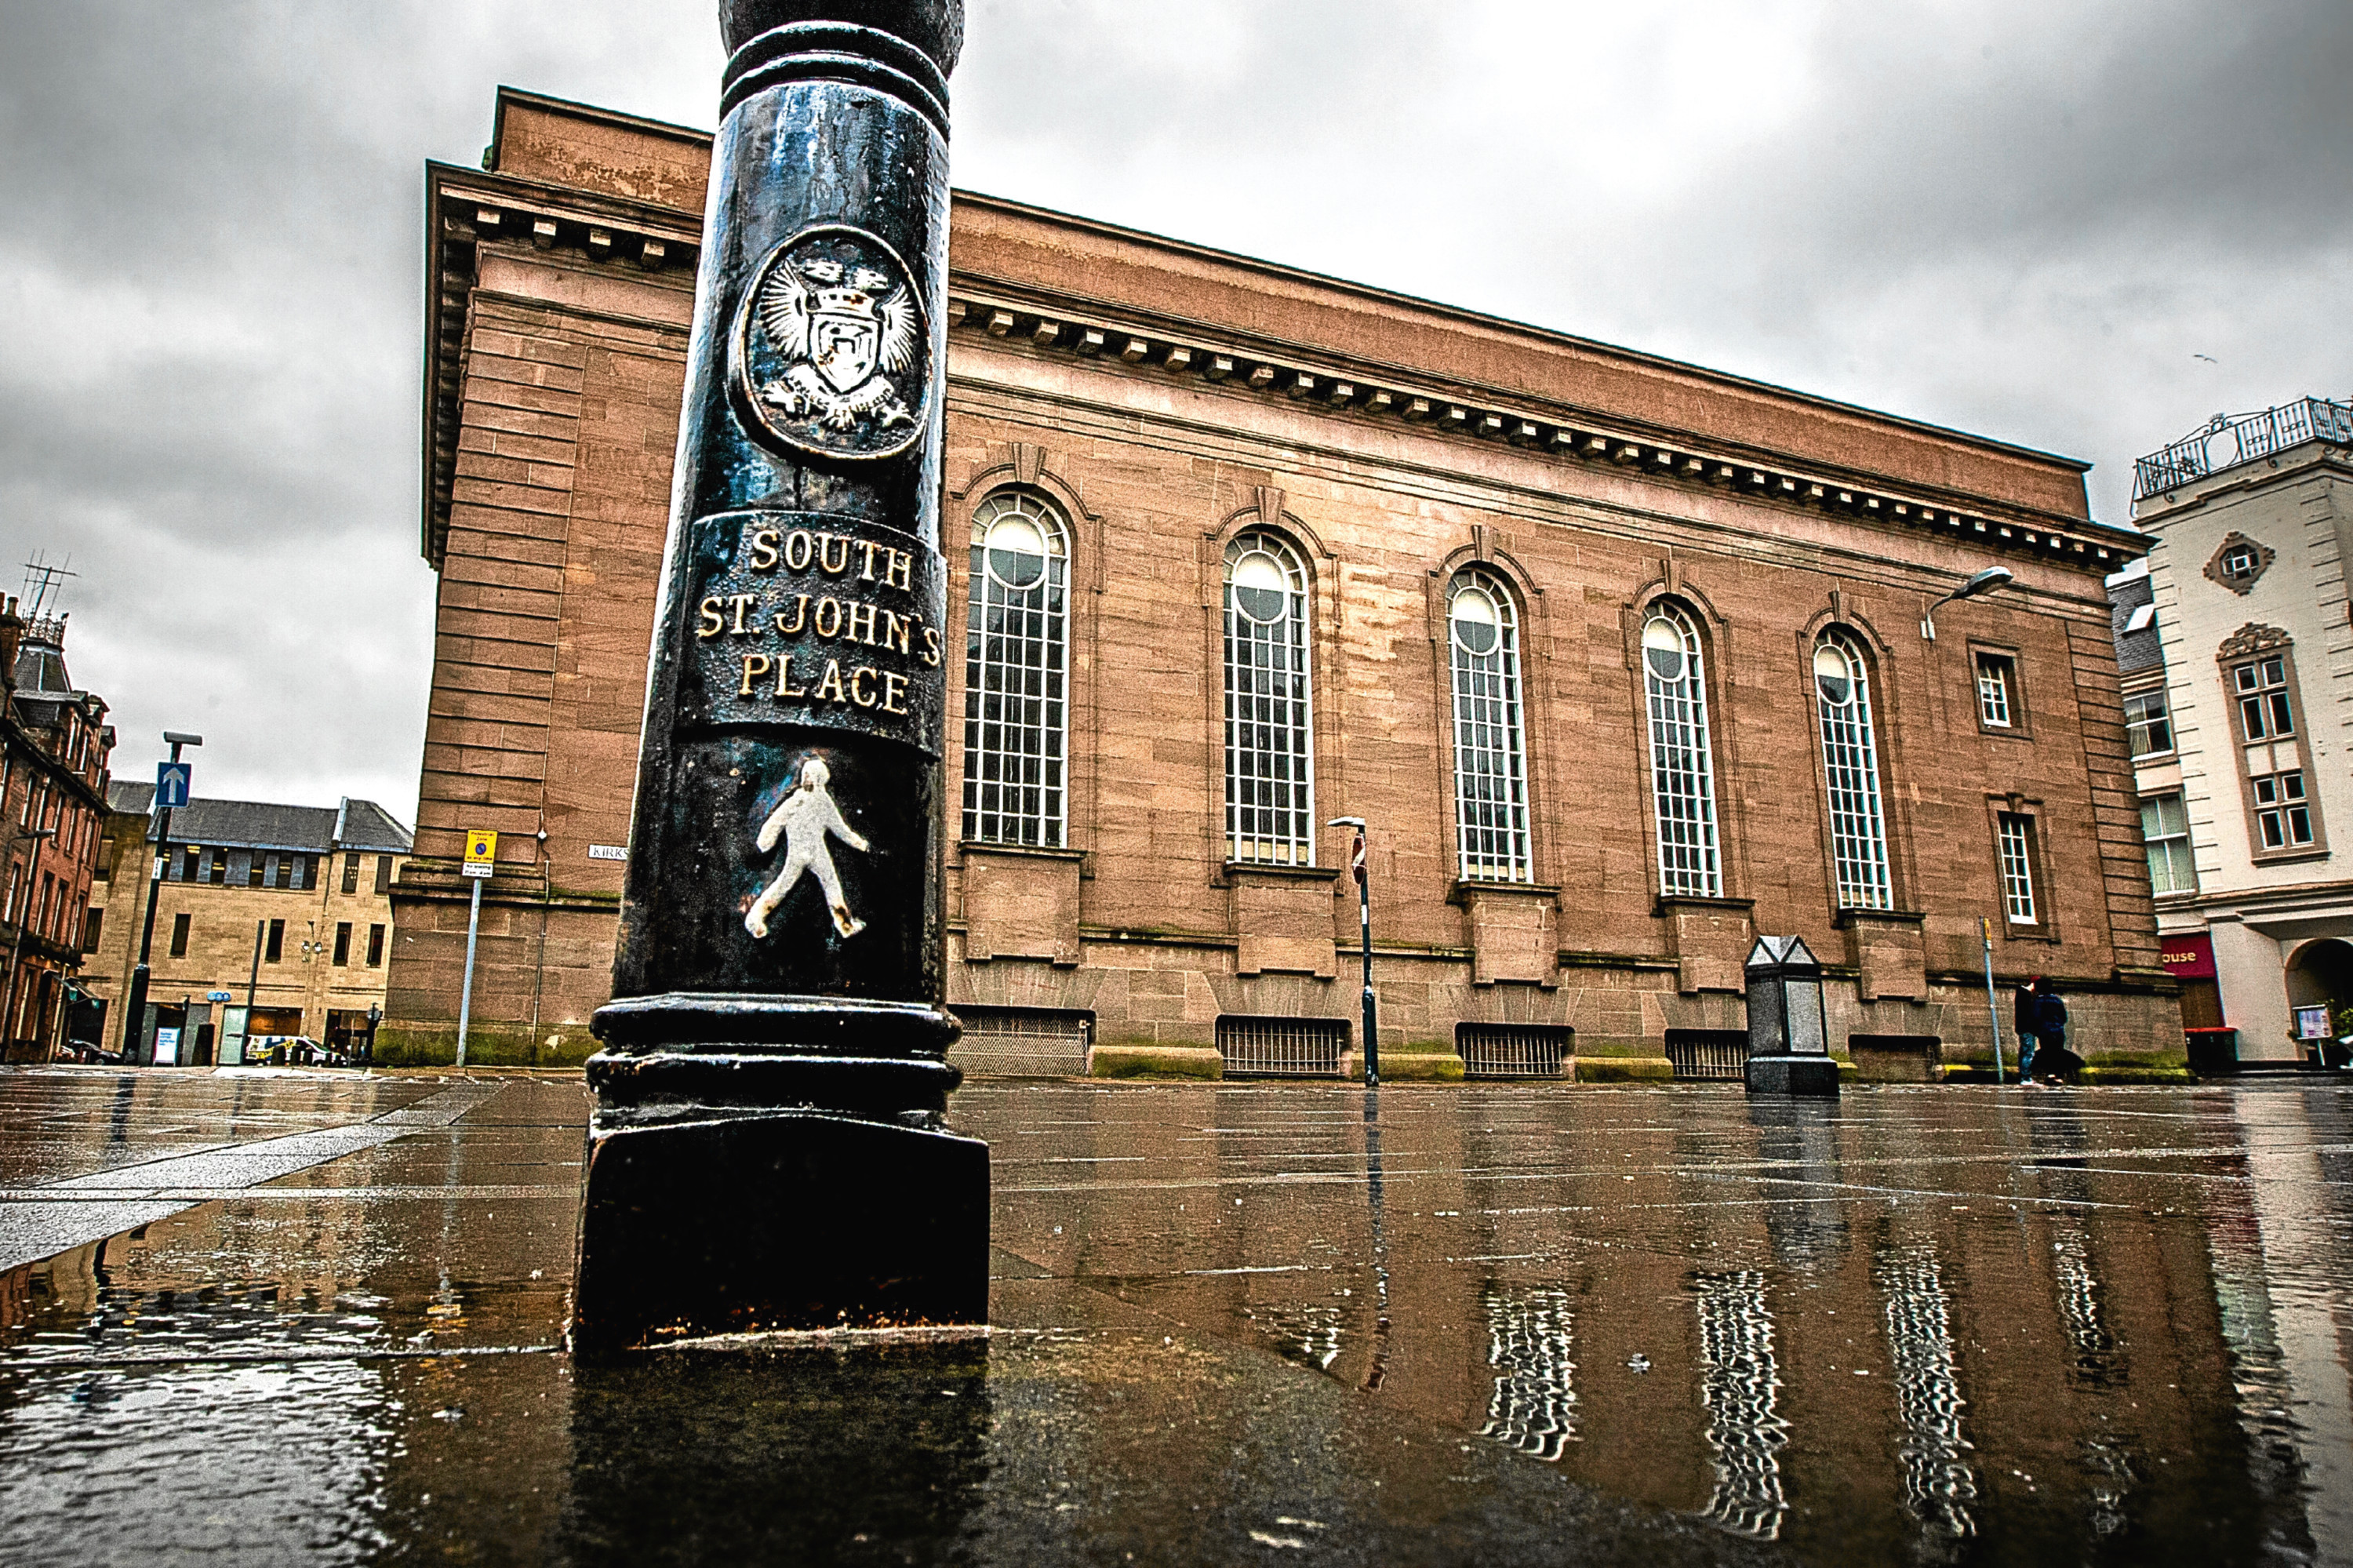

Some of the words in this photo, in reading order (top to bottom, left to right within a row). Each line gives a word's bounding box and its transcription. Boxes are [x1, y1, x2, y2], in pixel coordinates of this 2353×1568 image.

[751, 529, 911, 592] SOUTH
[697, 594, 762, 637] ST.
[773, 594, 940, 667] JOHN'S
[739, 654, 909, 715] PLACE
